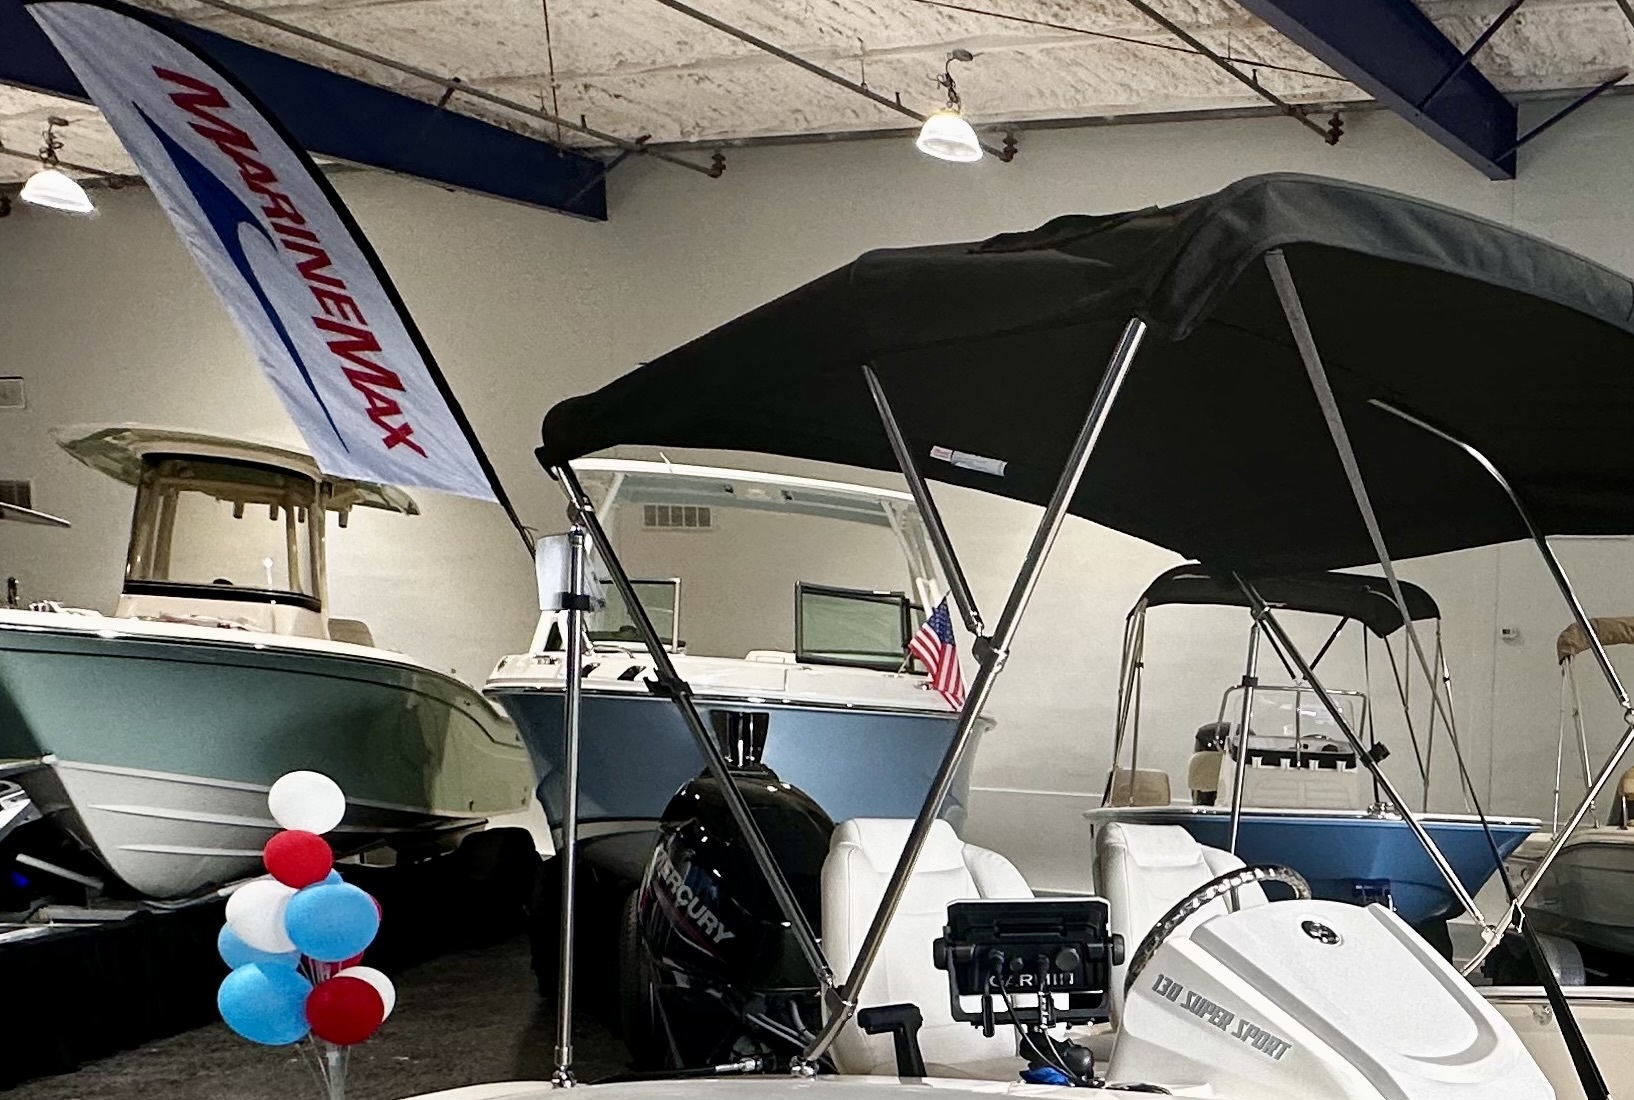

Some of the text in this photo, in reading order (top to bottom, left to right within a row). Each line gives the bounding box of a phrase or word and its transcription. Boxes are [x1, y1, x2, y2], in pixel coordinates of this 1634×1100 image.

[151, 64, 429, 459] MARINEMAX
[1151, 973, 1293, 1060] 130 SUPER SPORT
